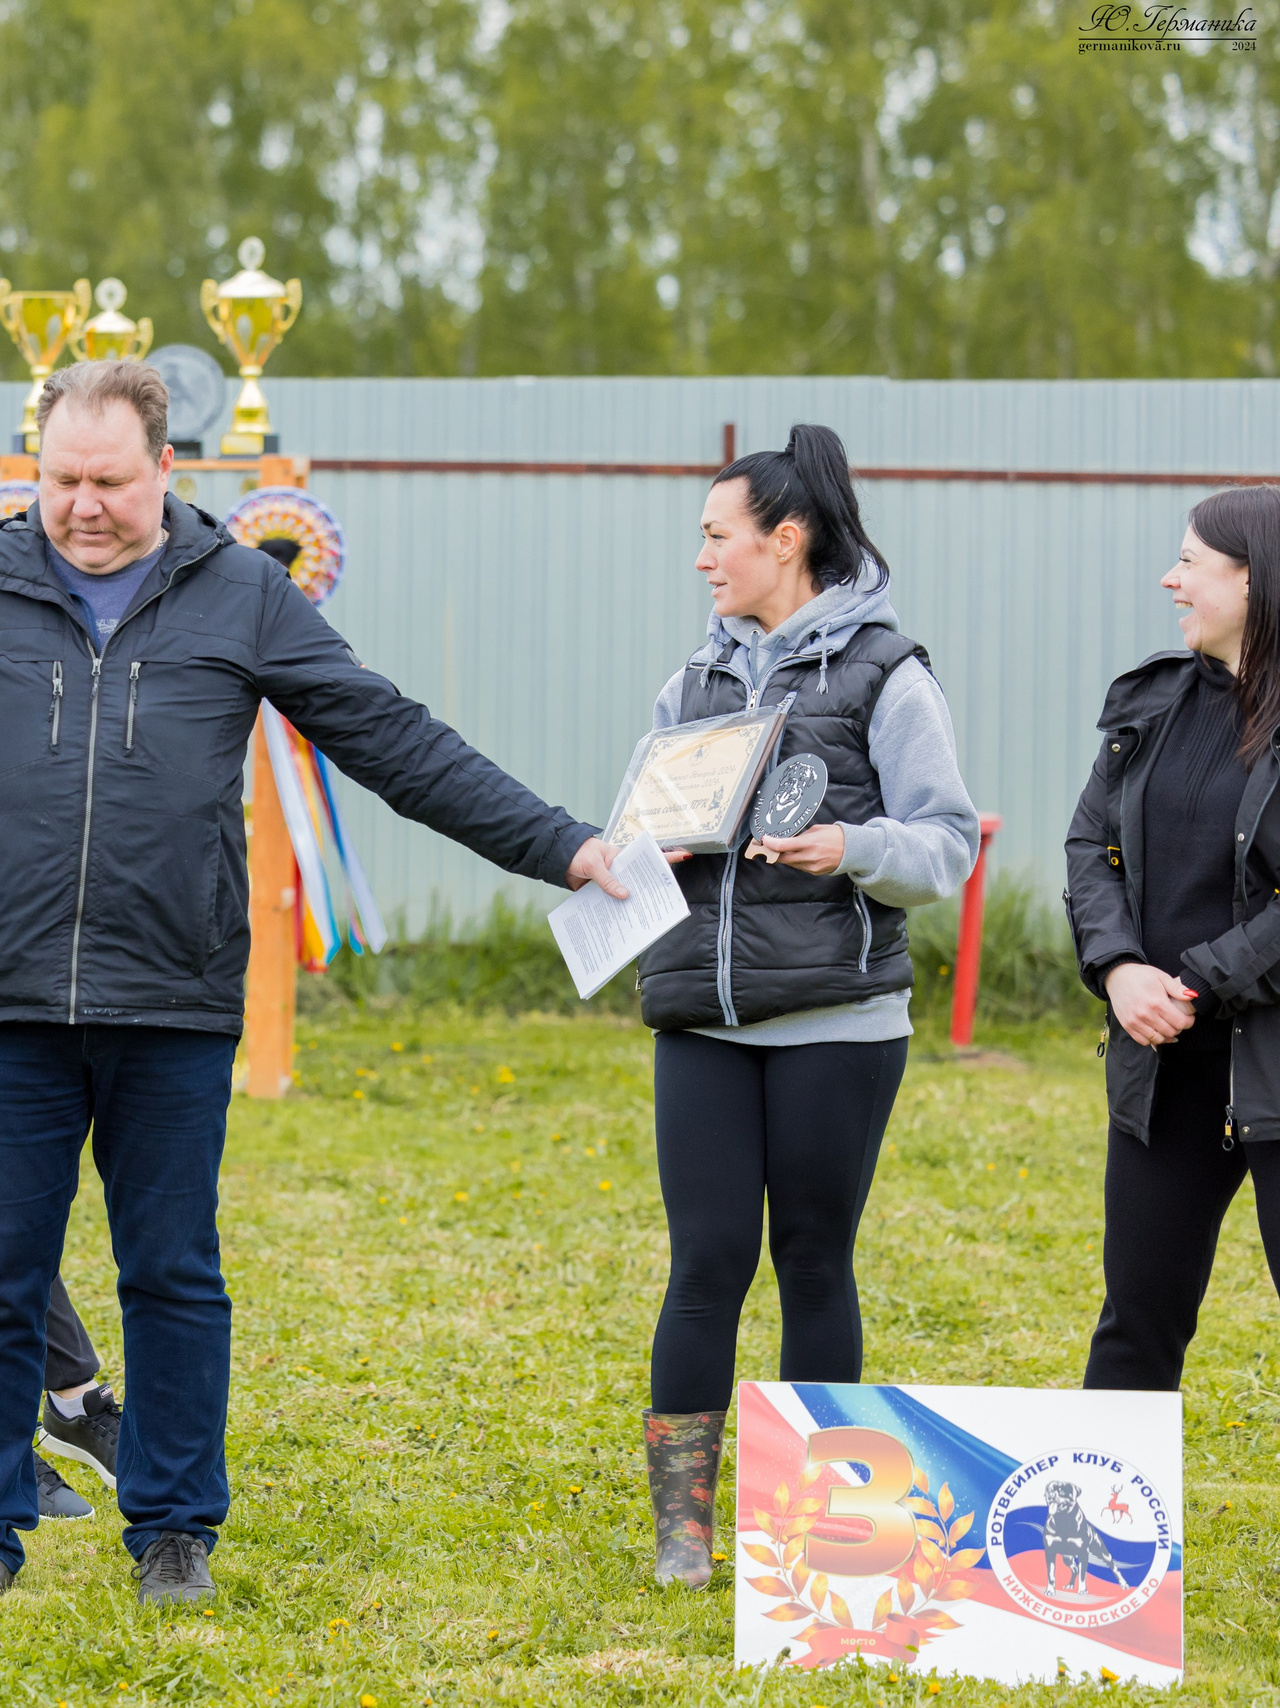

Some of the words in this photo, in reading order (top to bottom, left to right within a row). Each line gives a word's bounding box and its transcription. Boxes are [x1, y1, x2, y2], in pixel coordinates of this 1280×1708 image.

[804, 1426, 918, 1578] 3
[991, 1455, 1059, 1546] РОТВЕЙЛЕР
[1073, 1453, 1123, 1473] КЛУБ
[1131, 1475, 1169, 1550] РОССИИ
[1002, 1574, 1141, 1627] НИЖЕГОРОДСКОЕ
[1141, 1577, 1159, 1597] РО
